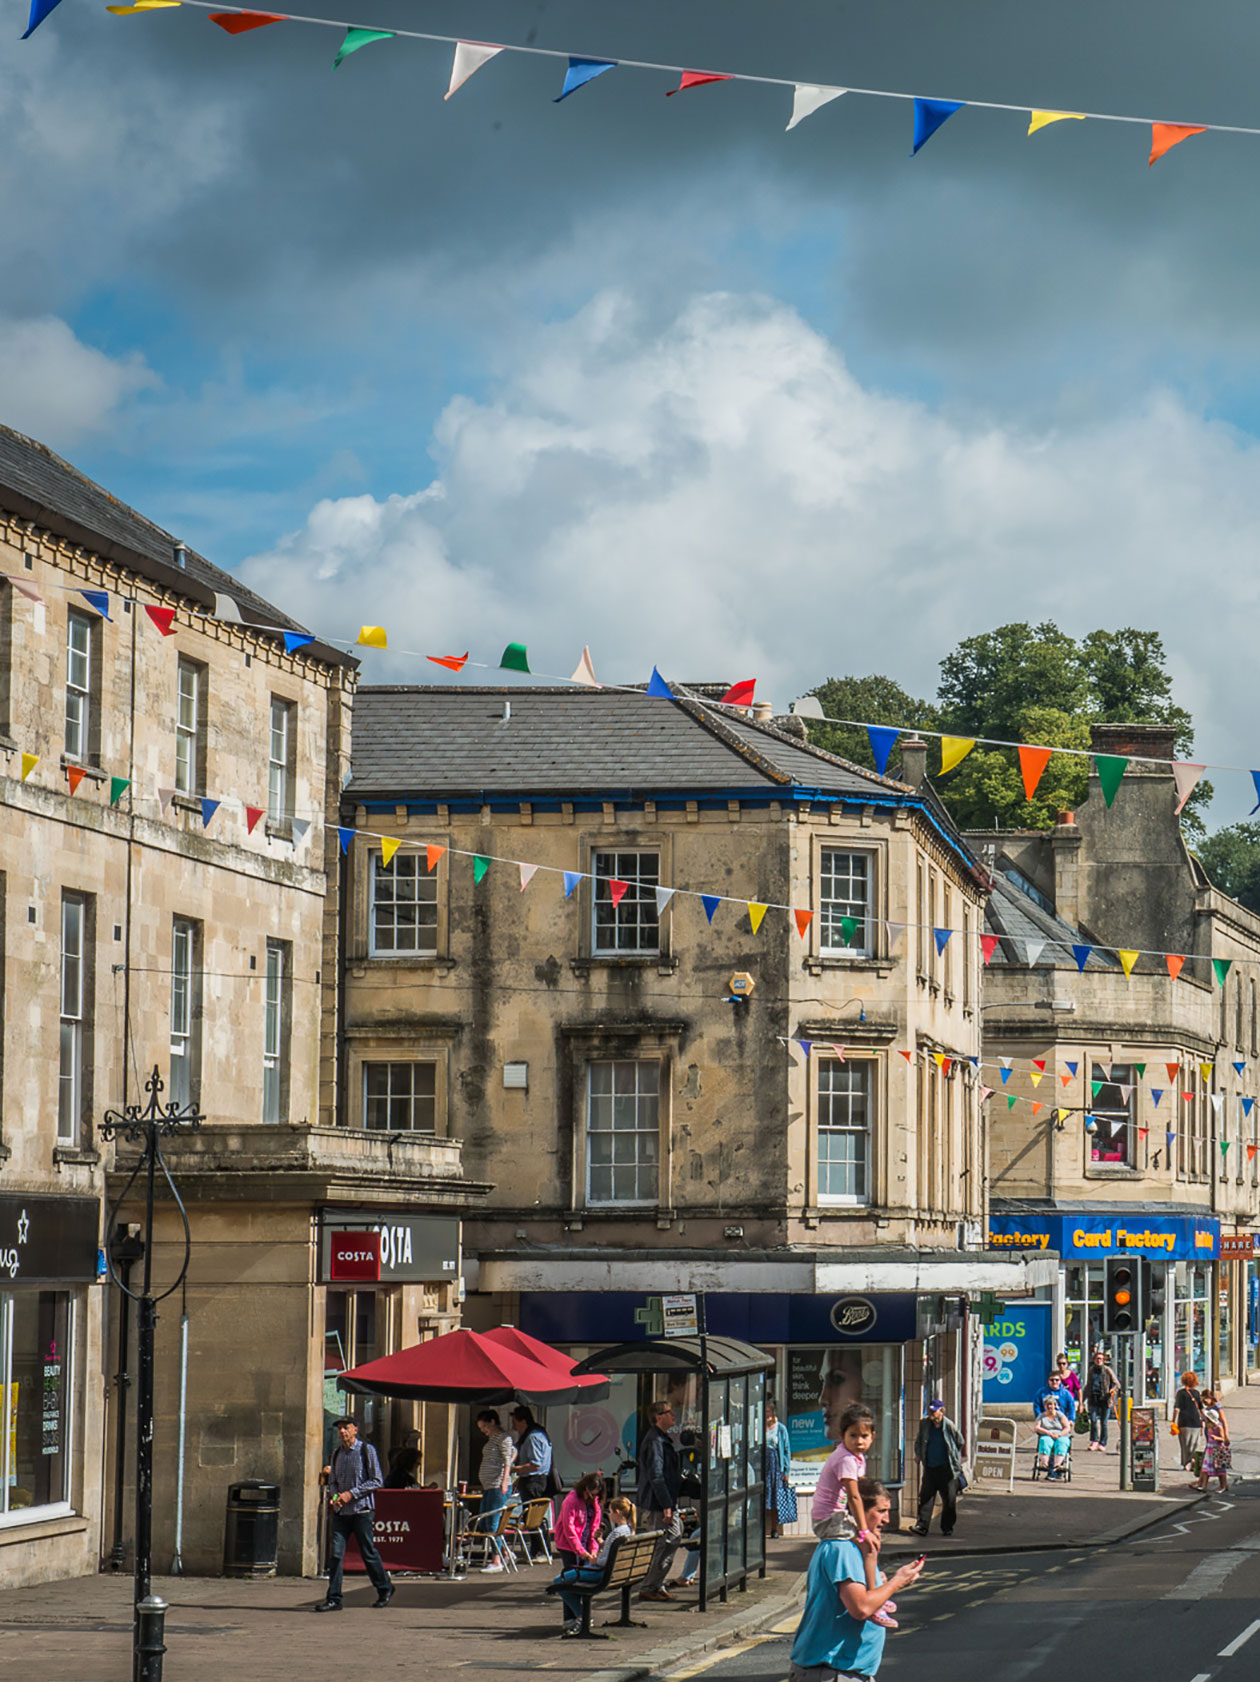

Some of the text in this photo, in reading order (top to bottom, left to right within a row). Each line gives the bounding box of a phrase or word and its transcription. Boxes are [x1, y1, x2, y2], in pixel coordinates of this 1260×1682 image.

[1072, 1229, 1112, 1248] Card
[1116, 1229, 1177, 1252] Factory
[1220, 1240, 1252, 1250] HARE
[372, 1225, 413, 1270] OSTA
[337, 1251, 375, 1263] COSTA
[792, 1382, 810, 1390] think
[792, 1391, 819, 1401] deeper
[792, 1419, 815, 1429] new
[982, 1467, 1004, 1478] OPEN
